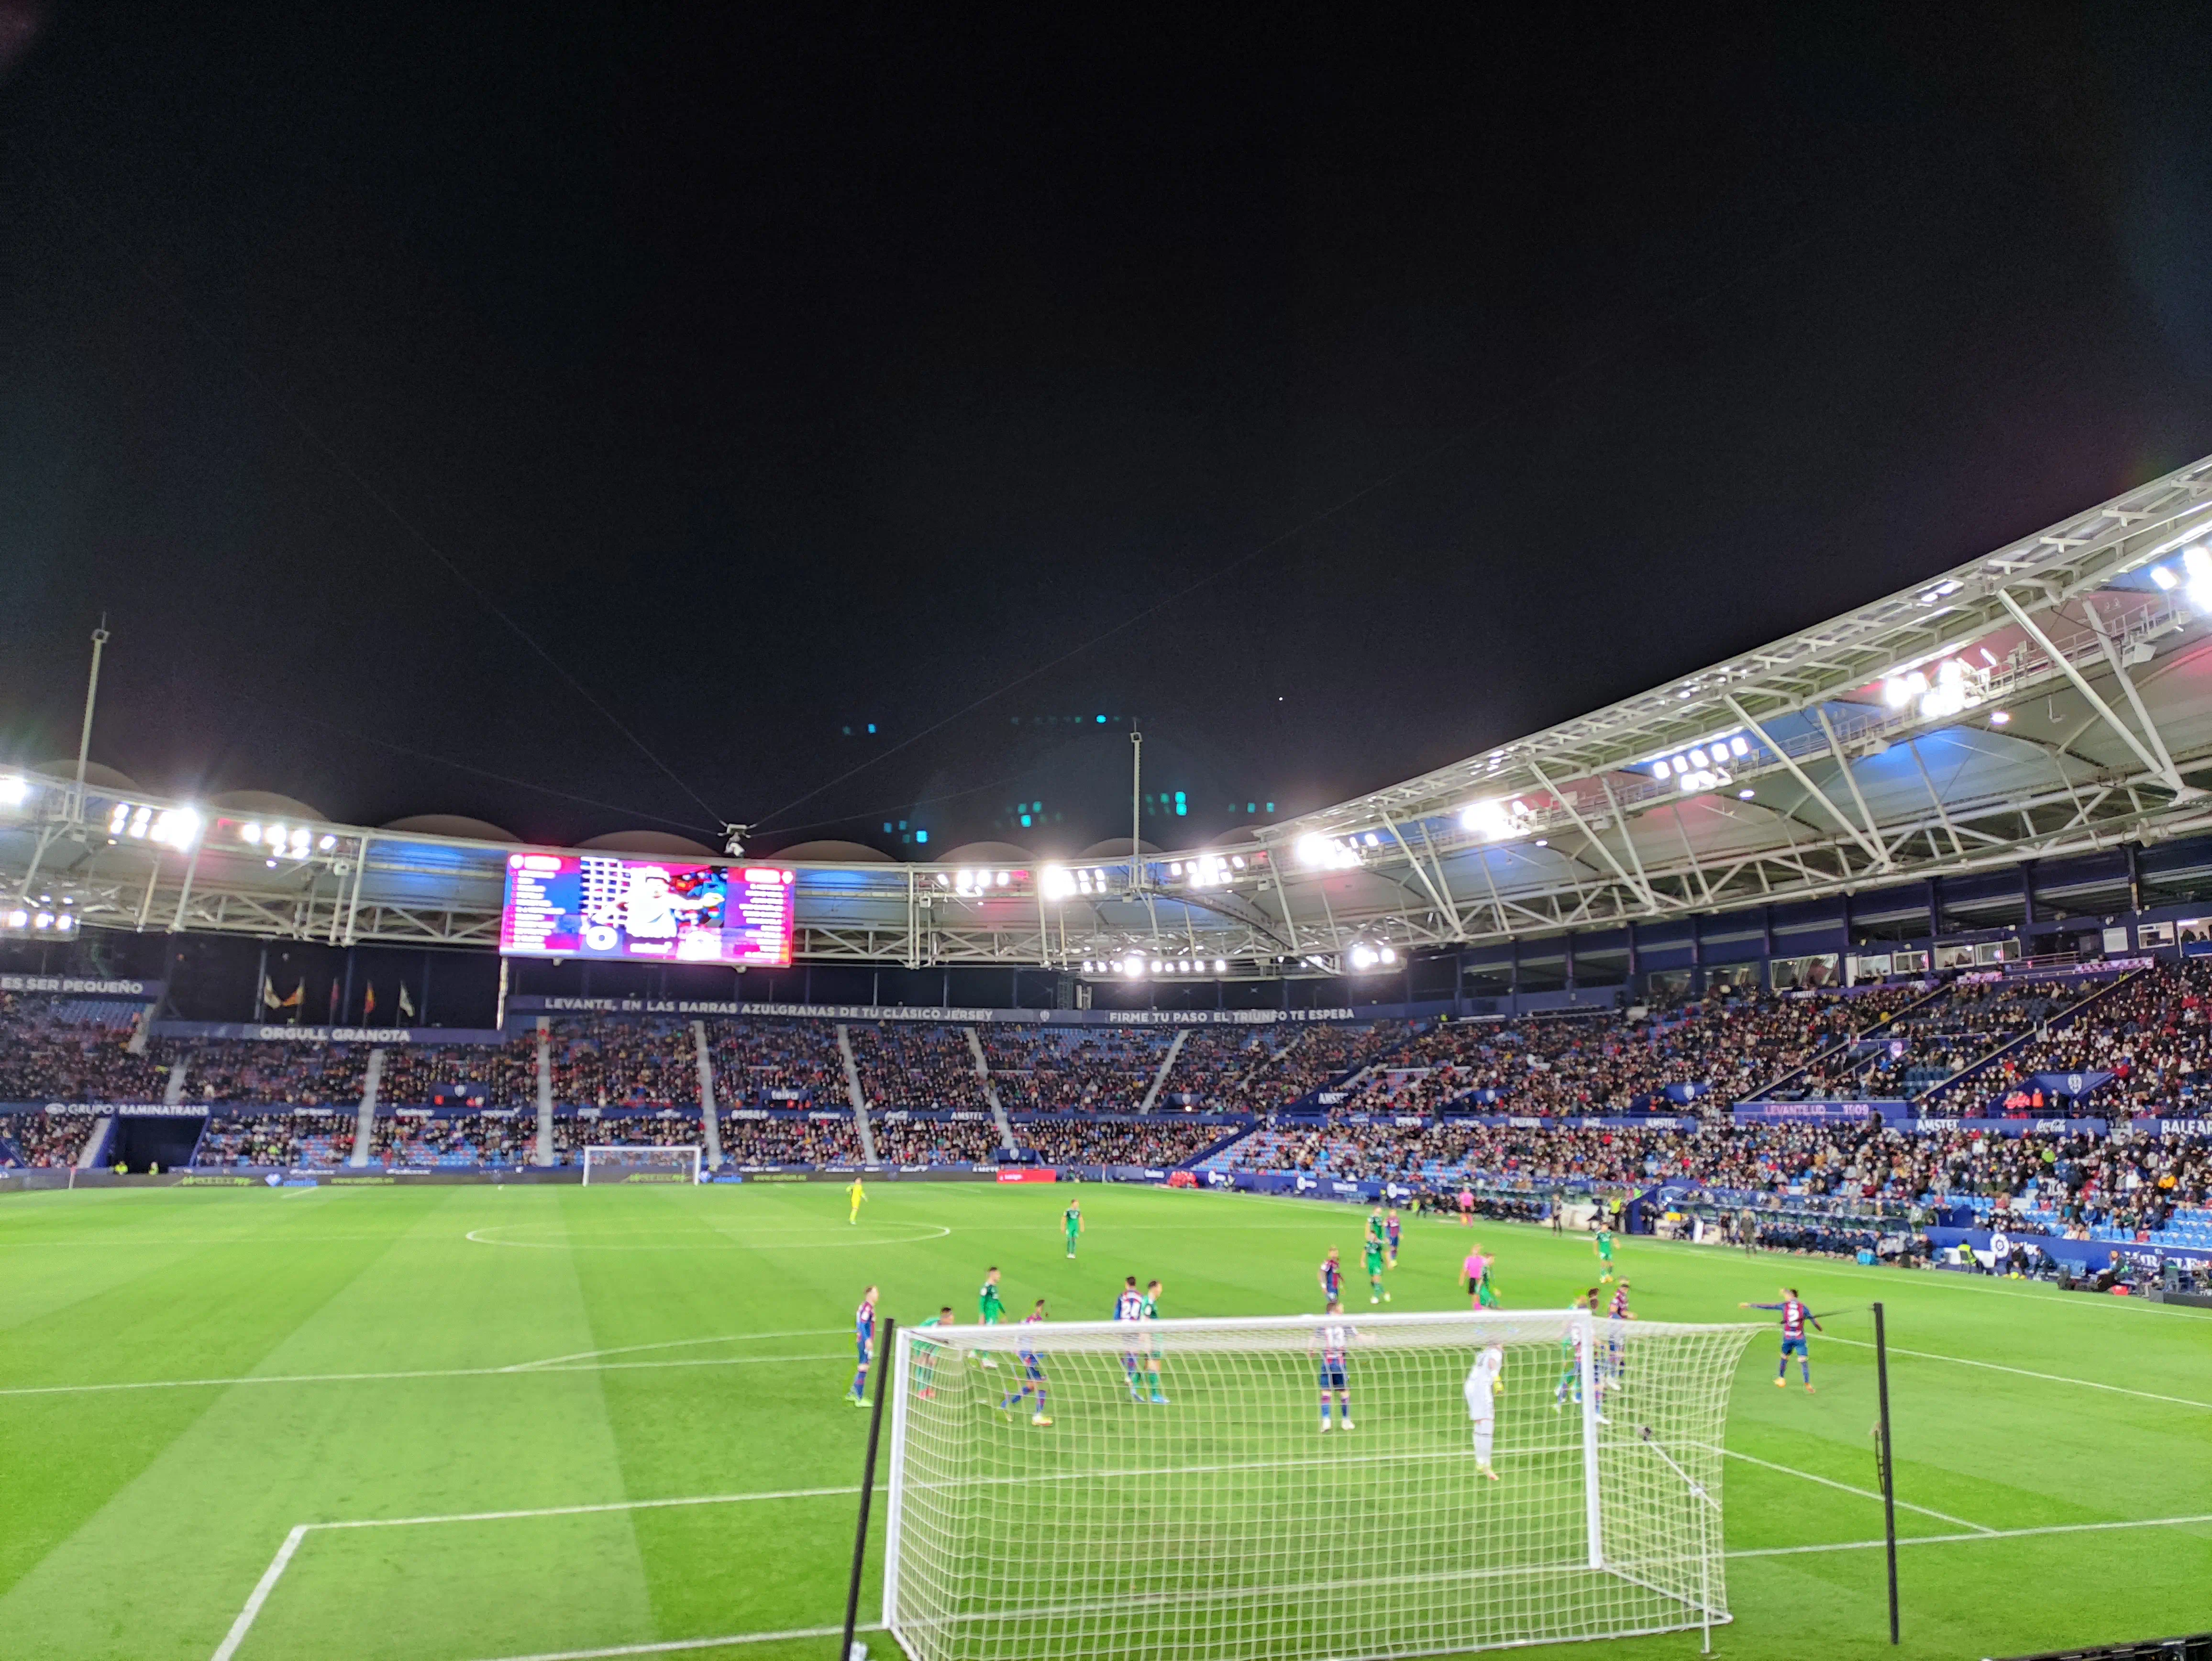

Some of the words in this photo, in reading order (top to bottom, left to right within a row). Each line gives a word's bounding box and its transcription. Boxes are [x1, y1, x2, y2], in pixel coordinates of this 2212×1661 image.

[26, 977, 59, 991] SER
[622, 1000, 641, 1011] EN
[647, 1001, 674, 1012] LAS
[678, 1002, 737, 1014] BARRAS
[741, 1004, 834, 1017] AZULGRANAS
[840, 1007, 859, 1018] DE
[862, 1008, 878, 1018] TU
[944, 1008, 993, 1021] JERSEY
[1110, 1012, 1148, 1022] FIRME
[1152, 1012, 1169, 1023] TU
[1173, 1012, 1207, 1023] PASO
[1213, 1011, 1228, 1022] EL
[1232, 1009, 1287, 1022] TRIUNFO
[1290, 1010, 1306, 1021] TE
[1308, 1008, 1355, 1020] ESPERA
[260, 1027, 328, 1041] ORGULL
[332, 1028, 411, 1042] GRANOTA
[68, 1104, 115, 1116] GRUPO
